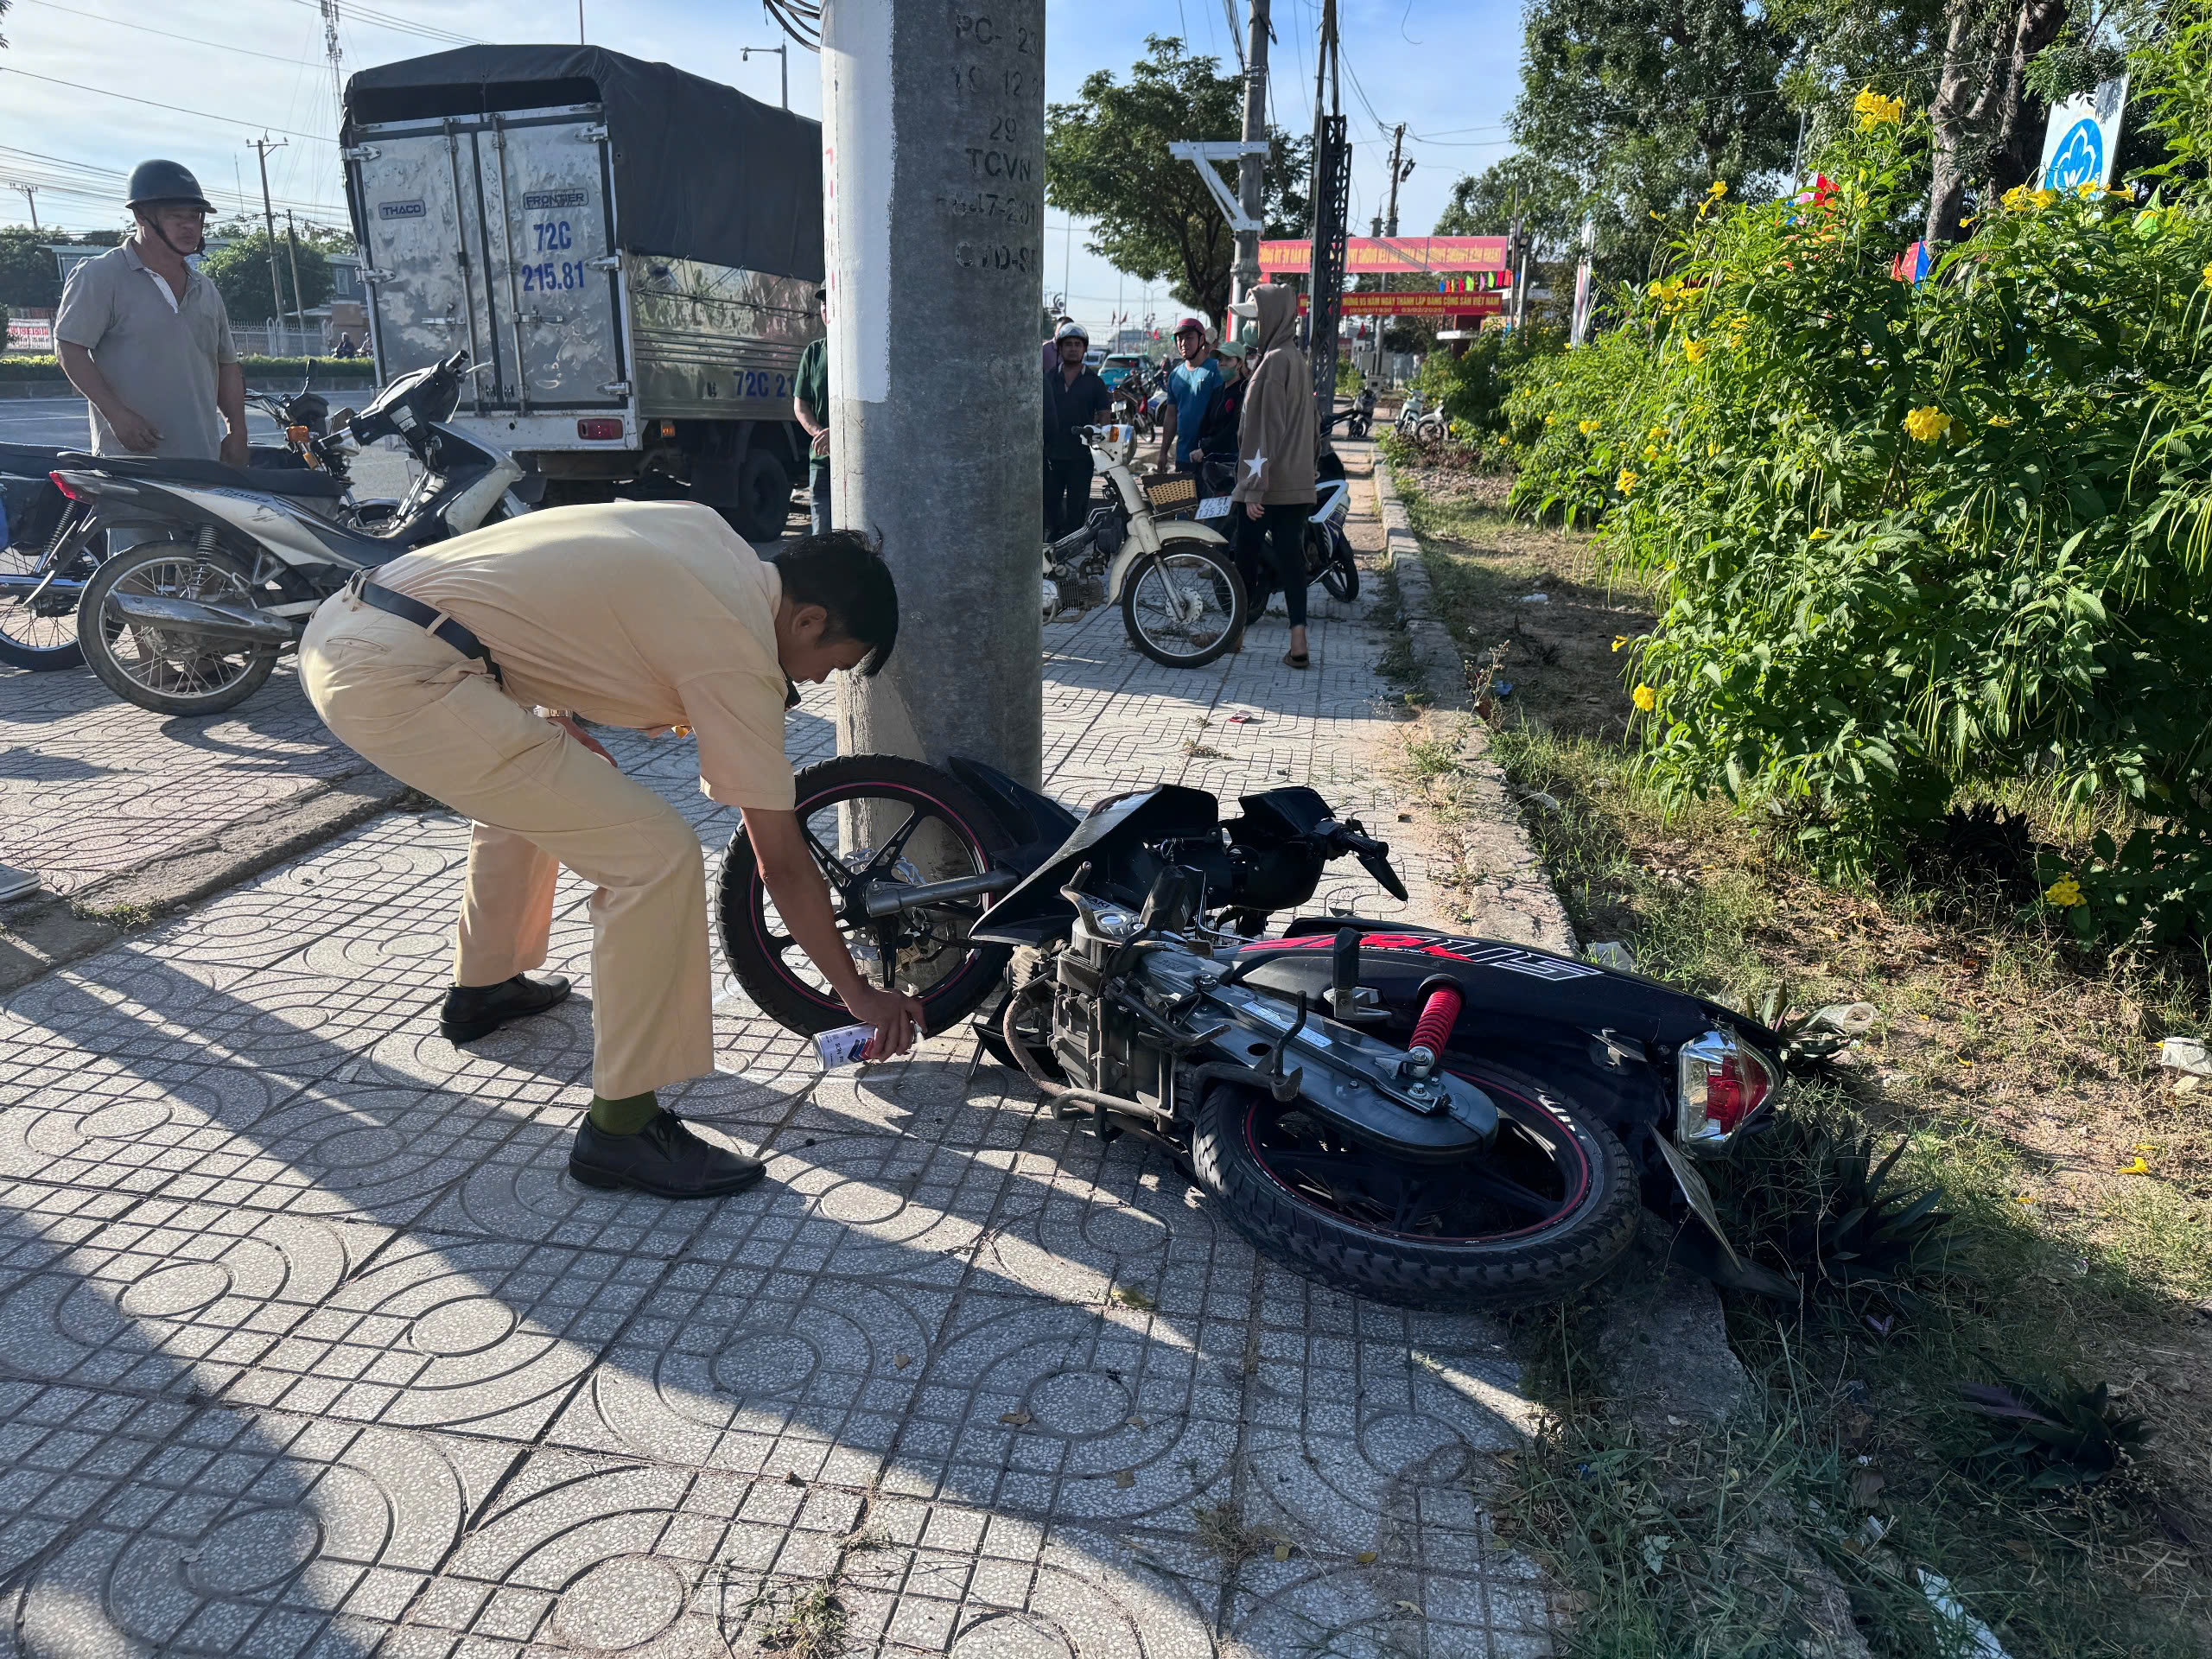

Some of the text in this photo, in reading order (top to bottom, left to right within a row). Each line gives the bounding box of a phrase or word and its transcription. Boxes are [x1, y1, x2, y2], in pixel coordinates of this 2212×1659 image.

[965, 148, 1031, 182] TCVN
[383, 204, 421, 215] THACO
[525, 193, 584, 207] FRONTIER
[533, 221, 572, 251] 72C
[522, 261, 584, 291] 215.81
[733, 370, 769, 397] 72C
